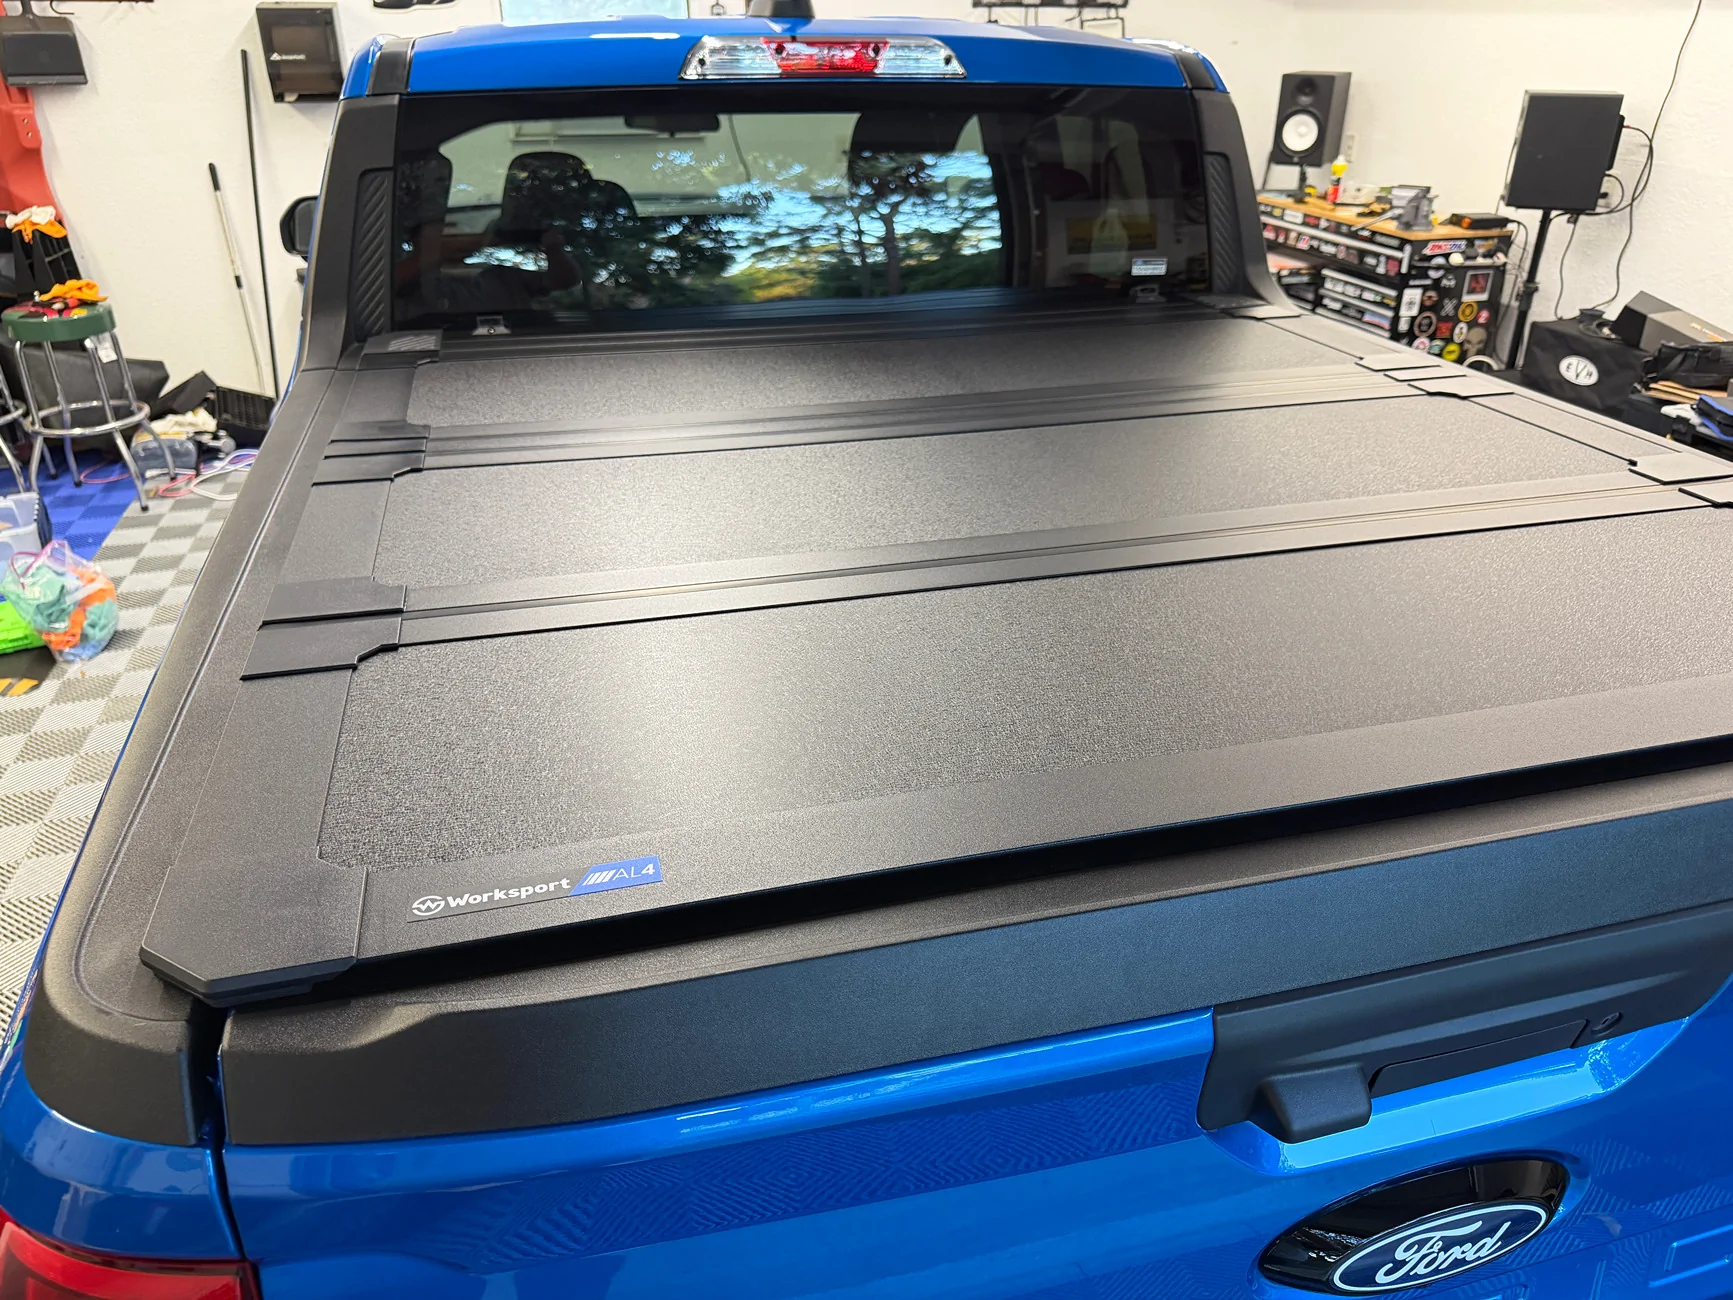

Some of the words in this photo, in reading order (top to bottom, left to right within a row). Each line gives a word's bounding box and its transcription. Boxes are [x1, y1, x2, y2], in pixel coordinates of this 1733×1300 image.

[1565, 359, 1594, 381] EVH
[446, 877, 571, 908] Worksport
[1375, 1221, 1511, 1284] Ford
